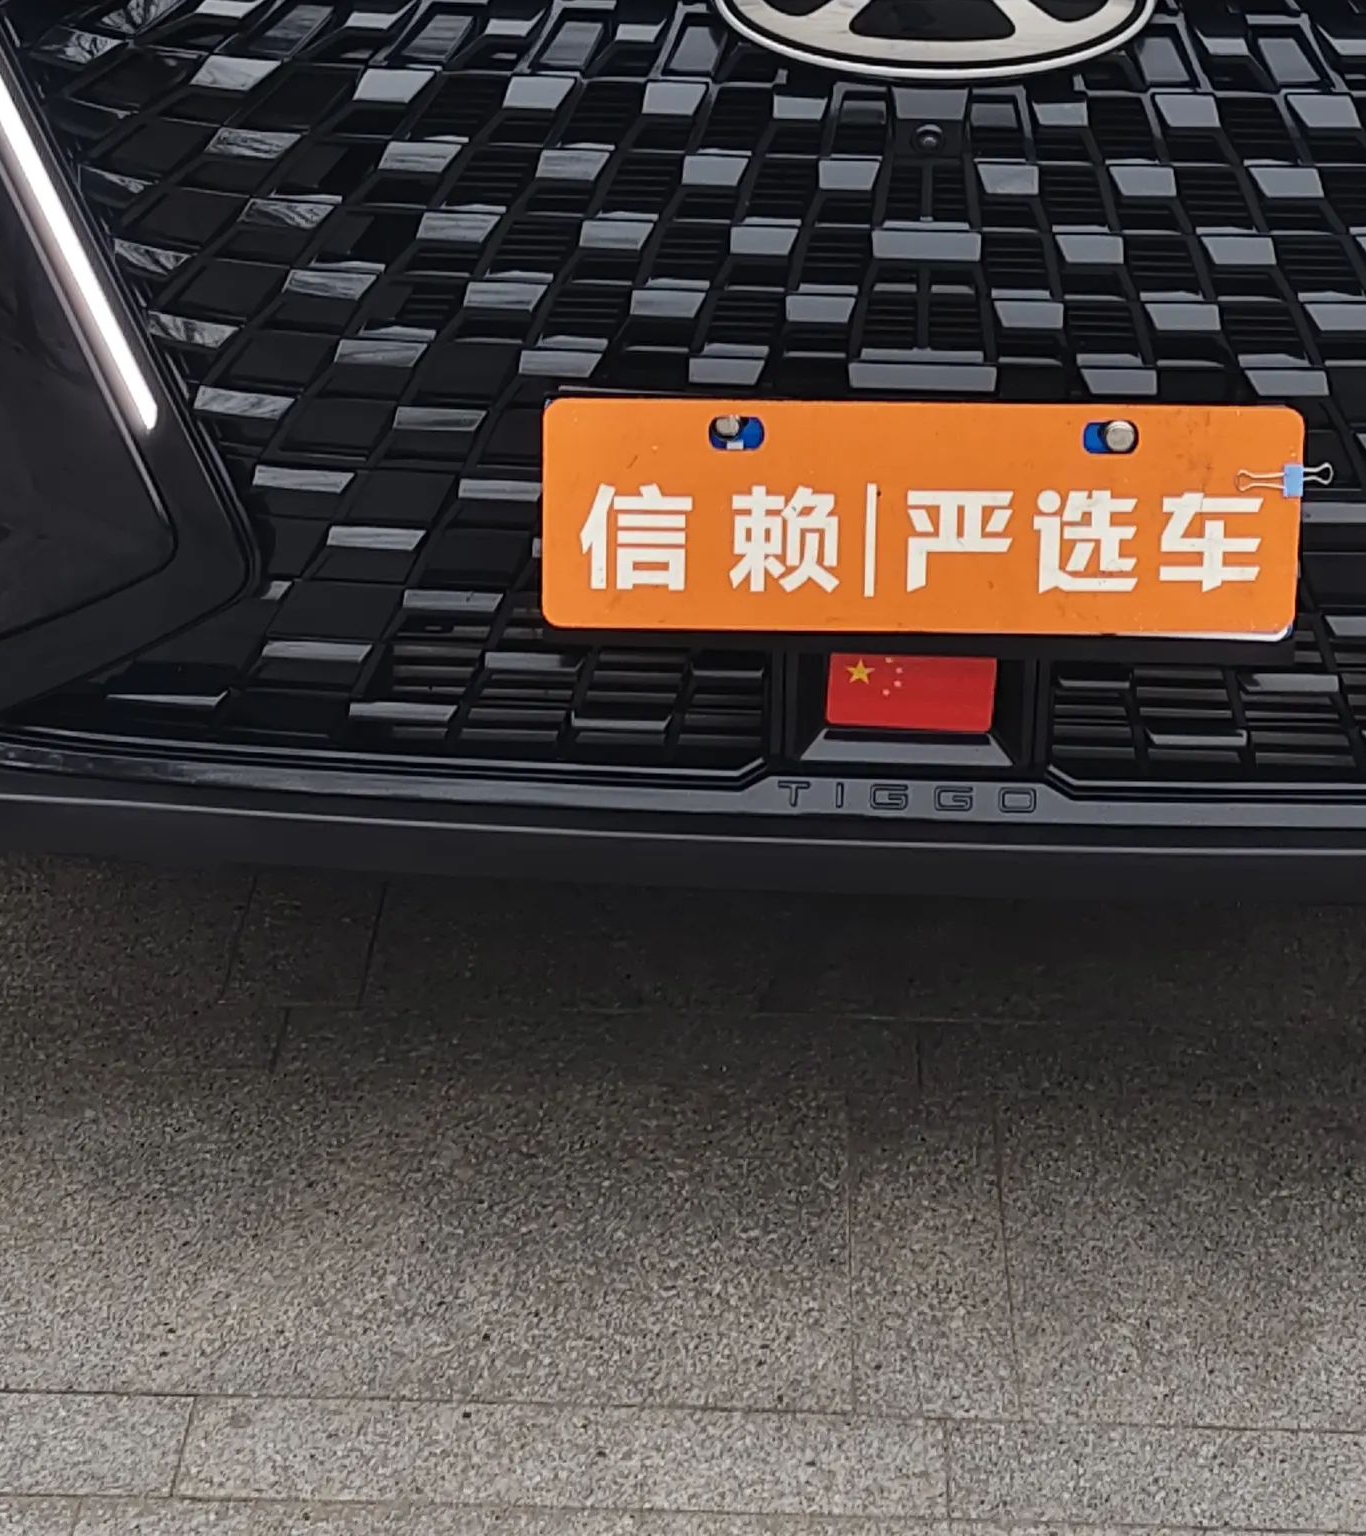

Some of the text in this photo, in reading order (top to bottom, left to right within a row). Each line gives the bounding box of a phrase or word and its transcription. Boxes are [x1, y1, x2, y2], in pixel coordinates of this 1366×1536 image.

[579, 482, 1265, 594] 信赖 严选车
[777, 779, 1038, 815] TIGGO
